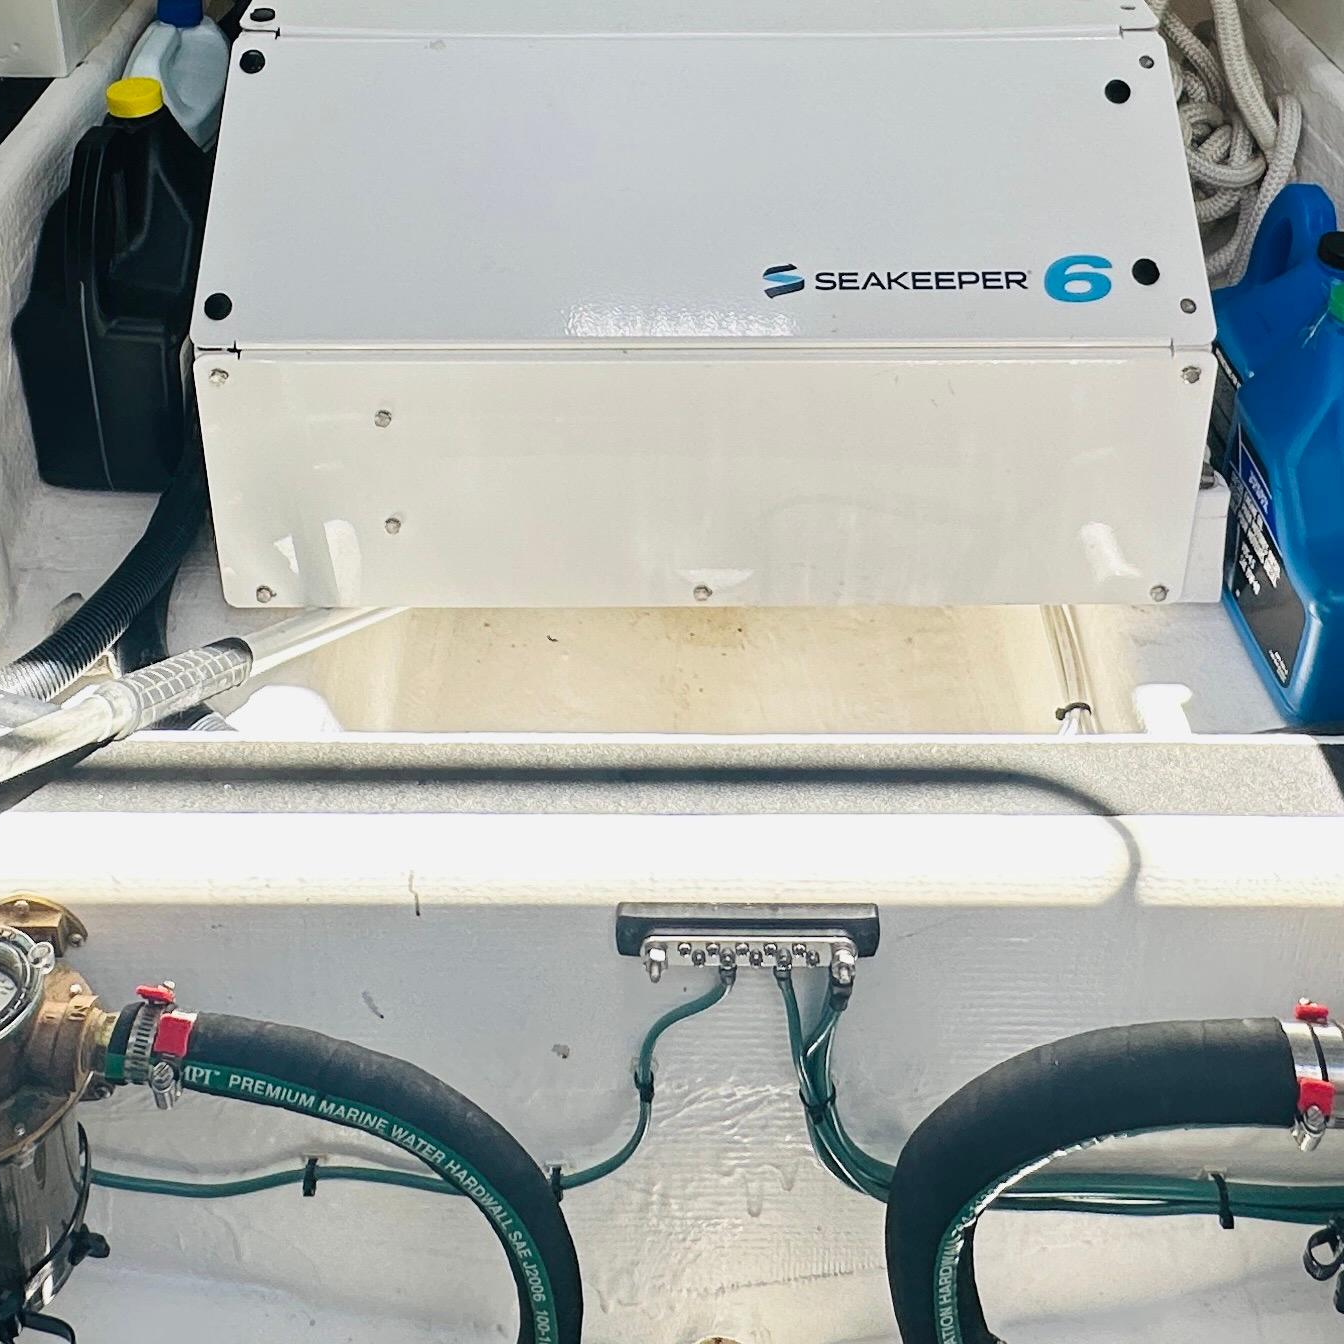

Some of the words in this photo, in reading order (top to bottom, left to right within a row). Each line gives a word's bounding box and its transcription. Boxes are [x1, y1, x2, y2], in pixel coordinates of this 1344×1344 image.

[814, 270, 1029, 291] SEAKEEPER
[1043, 254, 1113, 303] 6
[228, 1074, 315, 1109] PREMIUM
[318, 1100, 389, 1135] MARINE
[391, 1123, 445, 1164] WATER
[444, 1159, 513, 1231] HARDWALL
[508, 1230, 533, 1260] SAE
[523, 1261, 547, 1303] J2006
